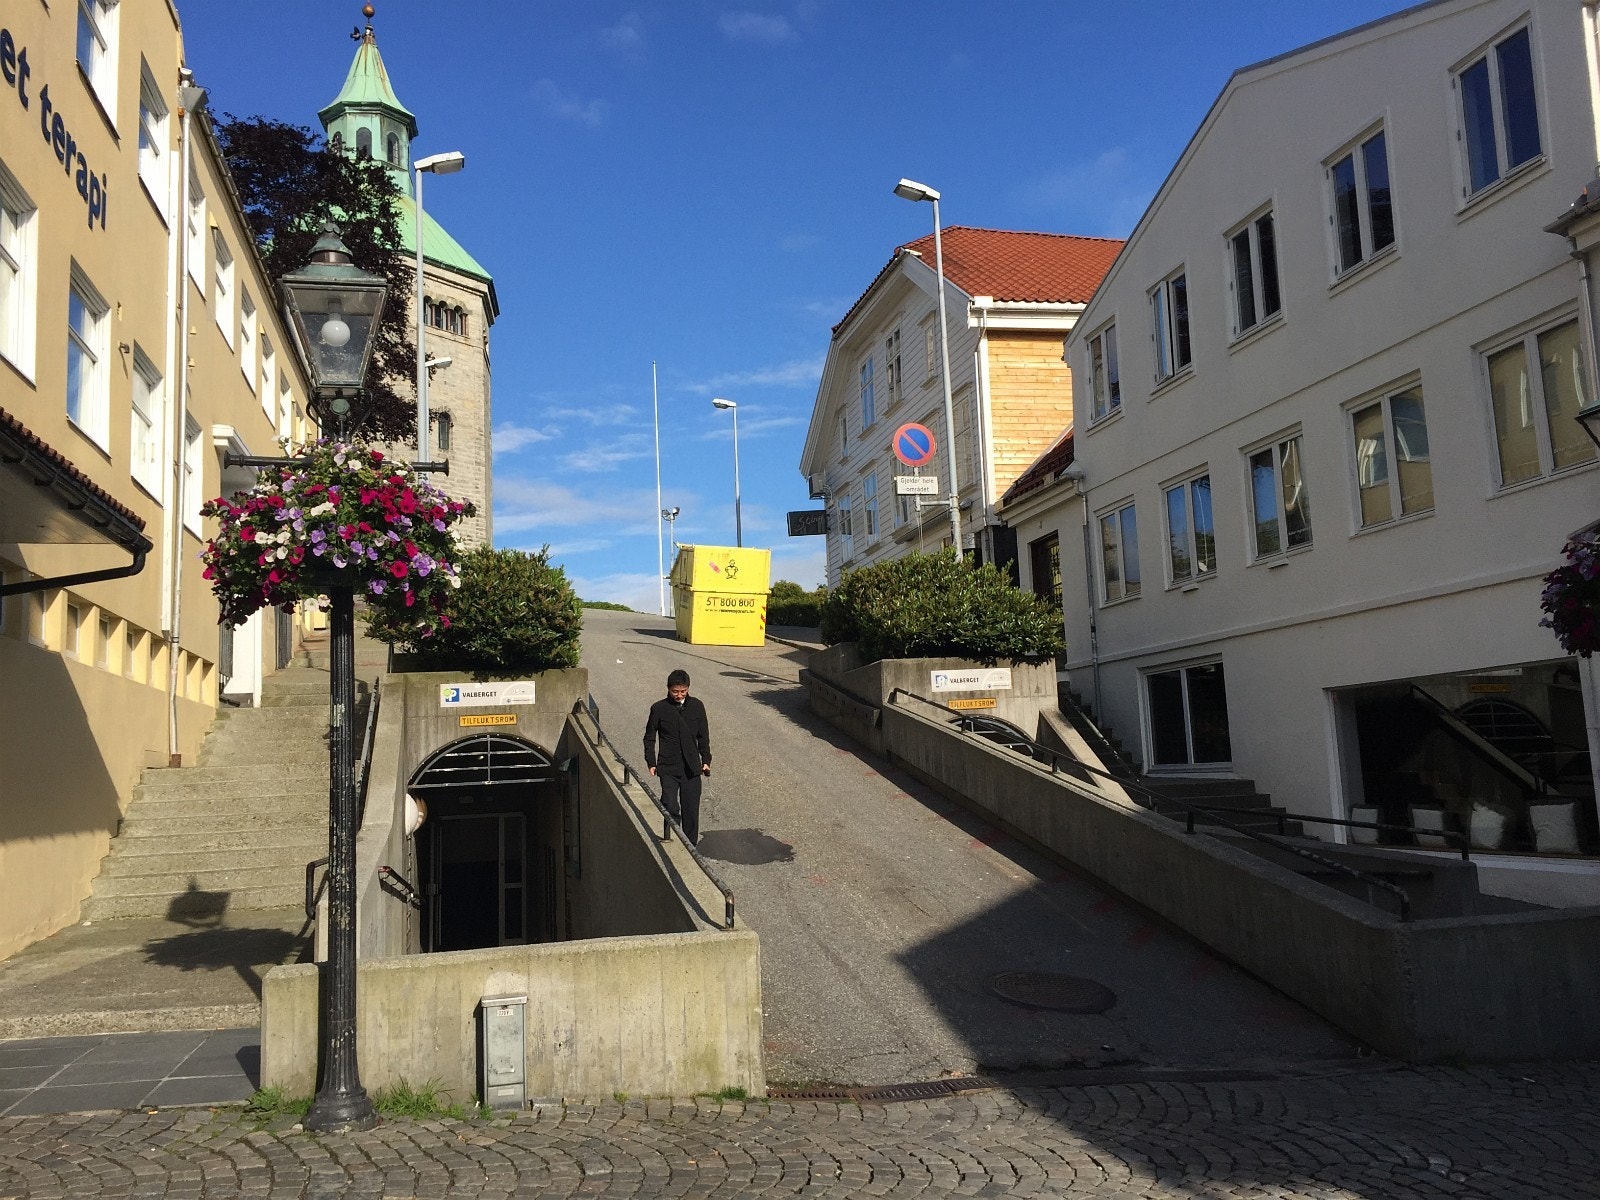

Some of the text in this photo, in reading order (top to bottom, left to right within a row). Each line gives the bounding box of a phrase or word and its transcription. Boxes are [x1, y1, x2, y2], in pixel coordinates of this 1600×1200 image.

[40, 83, 107, 231] terapi
[720, 598, 737, 607] 800
[738, 598, 755, 608] 800
[950, 700, 995, 708] TILFLUKTSROM
[462, 716, 515, 724] TILFLUKTSROM
